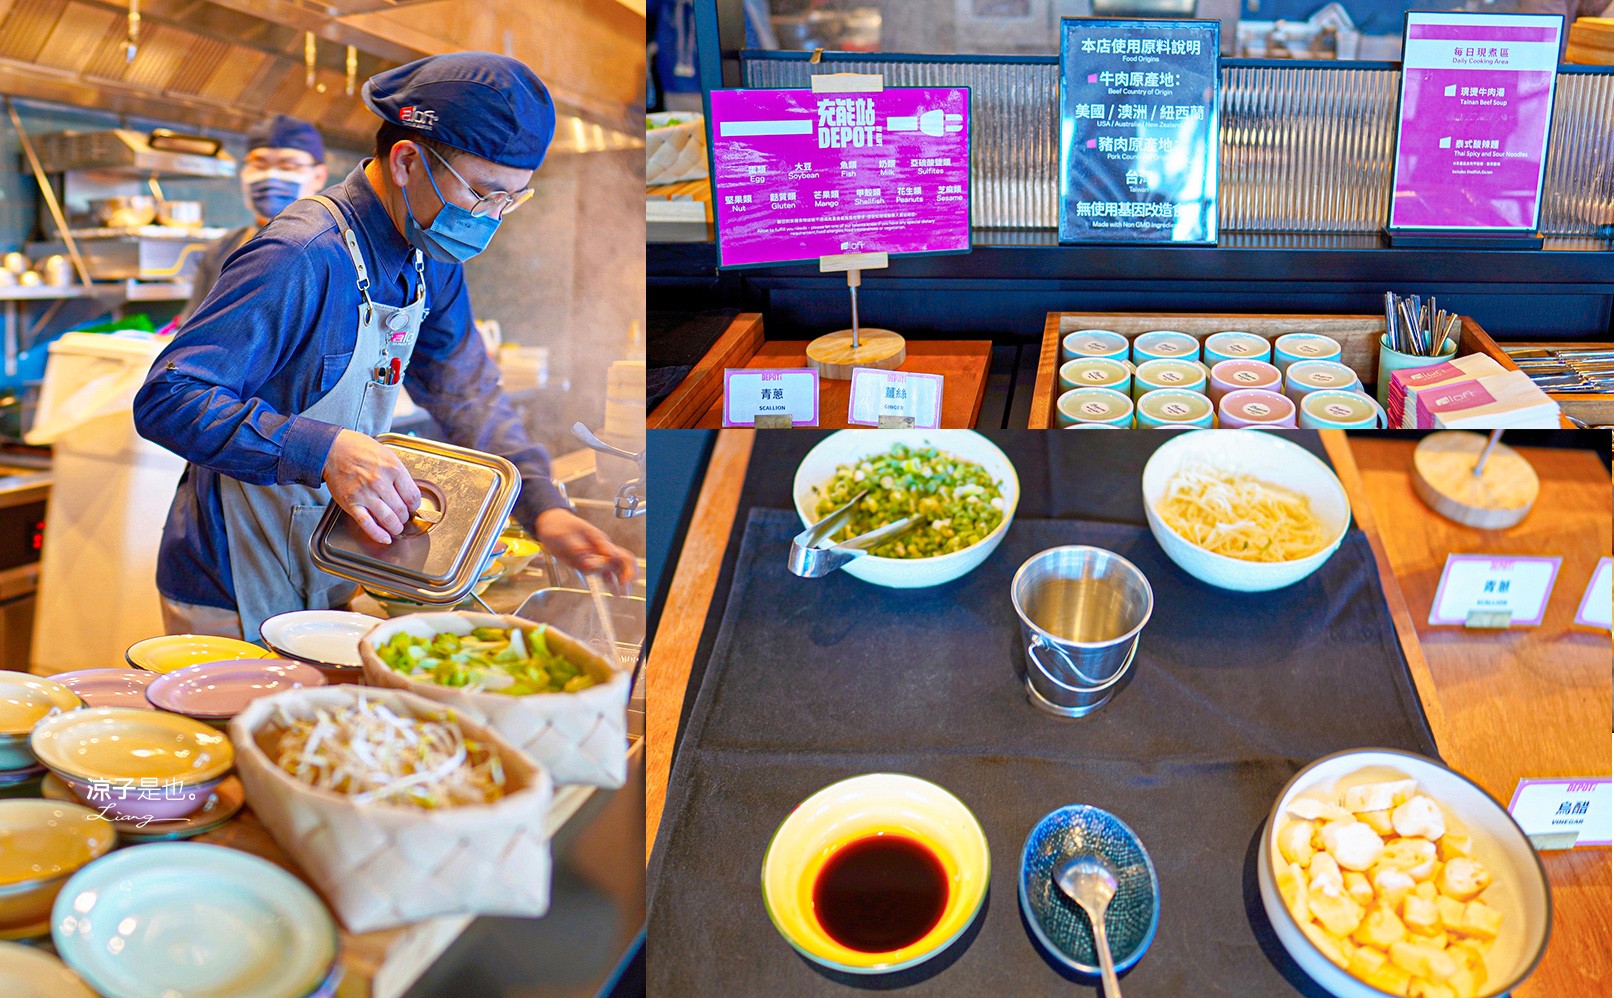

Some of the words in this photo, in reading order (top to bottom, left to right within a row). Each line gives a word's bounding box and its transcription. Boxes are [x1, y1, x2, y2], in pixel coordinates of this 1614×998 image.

[1081, 38, 1201, 55] 本店使用原料說明
[1454, 46, 1509, 58] 每日現煮區
[1139, 55, 1160, 63] Origins
[1099, 71, 1180, 87] 牛肉原產地：
[1122, 88, 1146, 96] Country
[1155, 88, 1173, 96] Origin
[400, 106, 438, 125] aloft
[817, 98, 875, 126] 充能站
[1075, 104, 1105, 119] 美國
[1108, 105, 1114, 120] /
[1118, 104, 1147, 120] 澳洲
[1160, 105, 1205, 121] 紐西蘭
[818, 126, 875, 148] DEPOT
[794, 162, 812, 171] 大豆
[840, 160, 857, 170] 魚類
[879, 160, 896, 168] 奶類
[788, 172, 820, 180] Soybean
[814, 190, 839, 199] 芒果類
[897, 186, 922, 196] 花生類
[936, 194, 963, 202] Sesame
[771, 202, 796, 210] Gluten
[391, 331, 414, 343] alo
